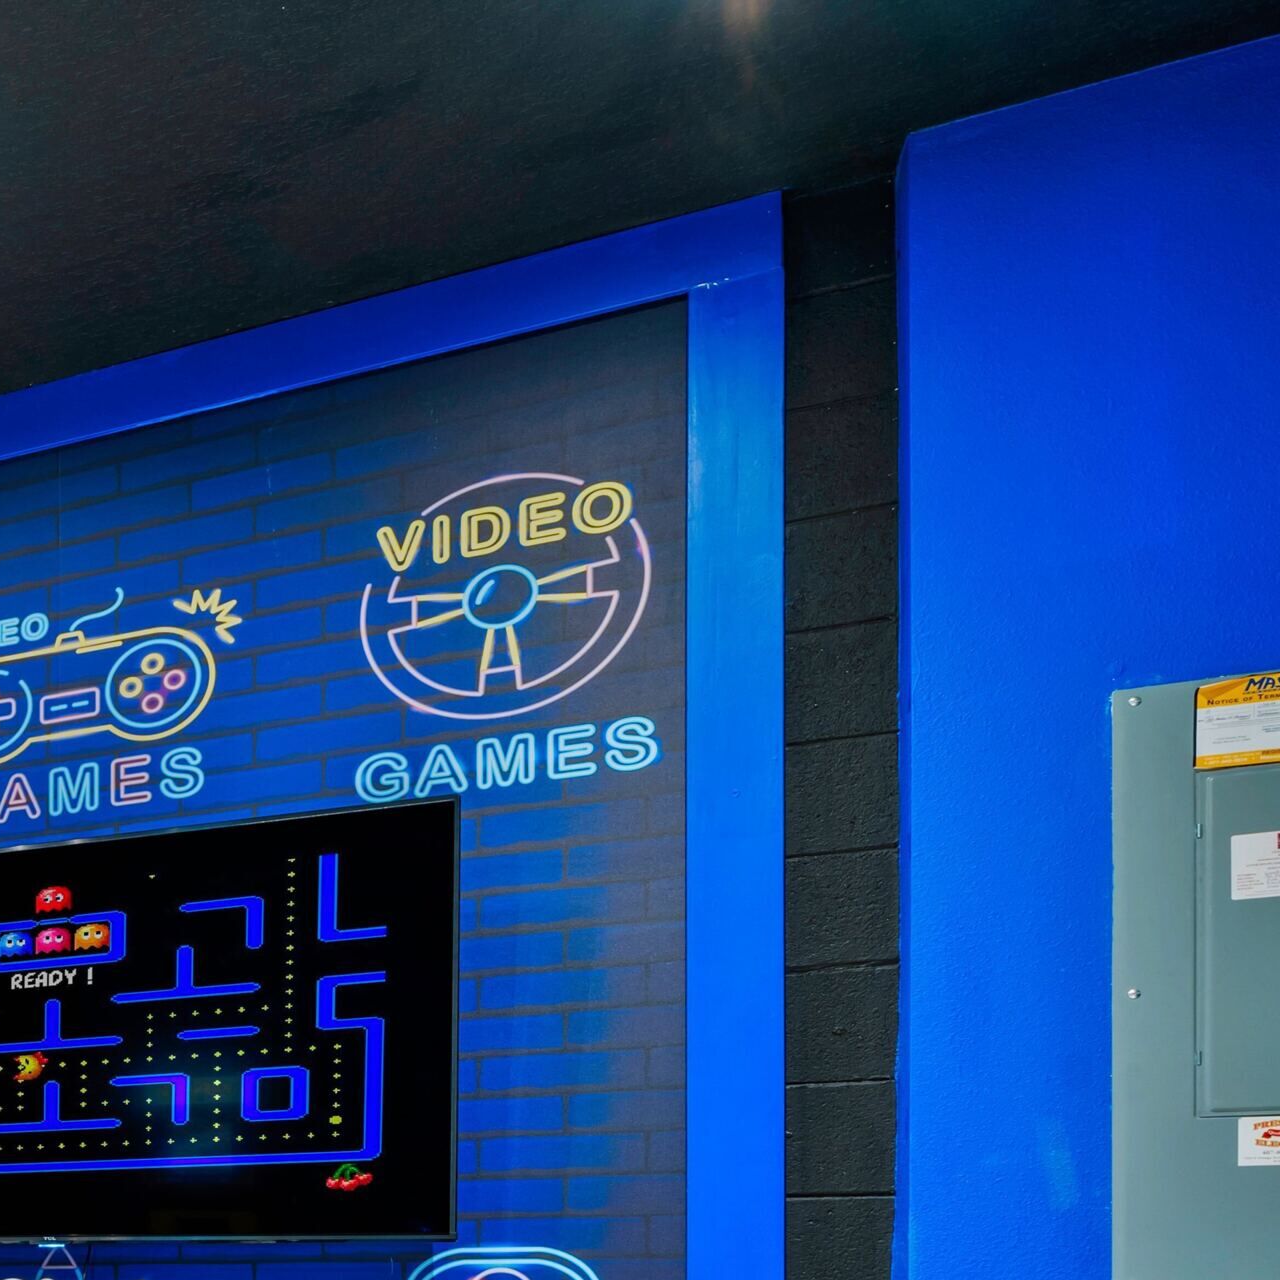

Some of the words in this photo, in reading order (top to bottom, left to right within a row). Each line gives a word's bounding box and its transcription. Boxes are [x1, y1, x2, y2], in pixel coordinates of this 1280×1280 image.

[376, 481, 633, 572] VIDEO
[1245, 676, 1280, 692] MA
[354, 716, 658, 803] GAMES
[11, 968, 77, 990] READY
